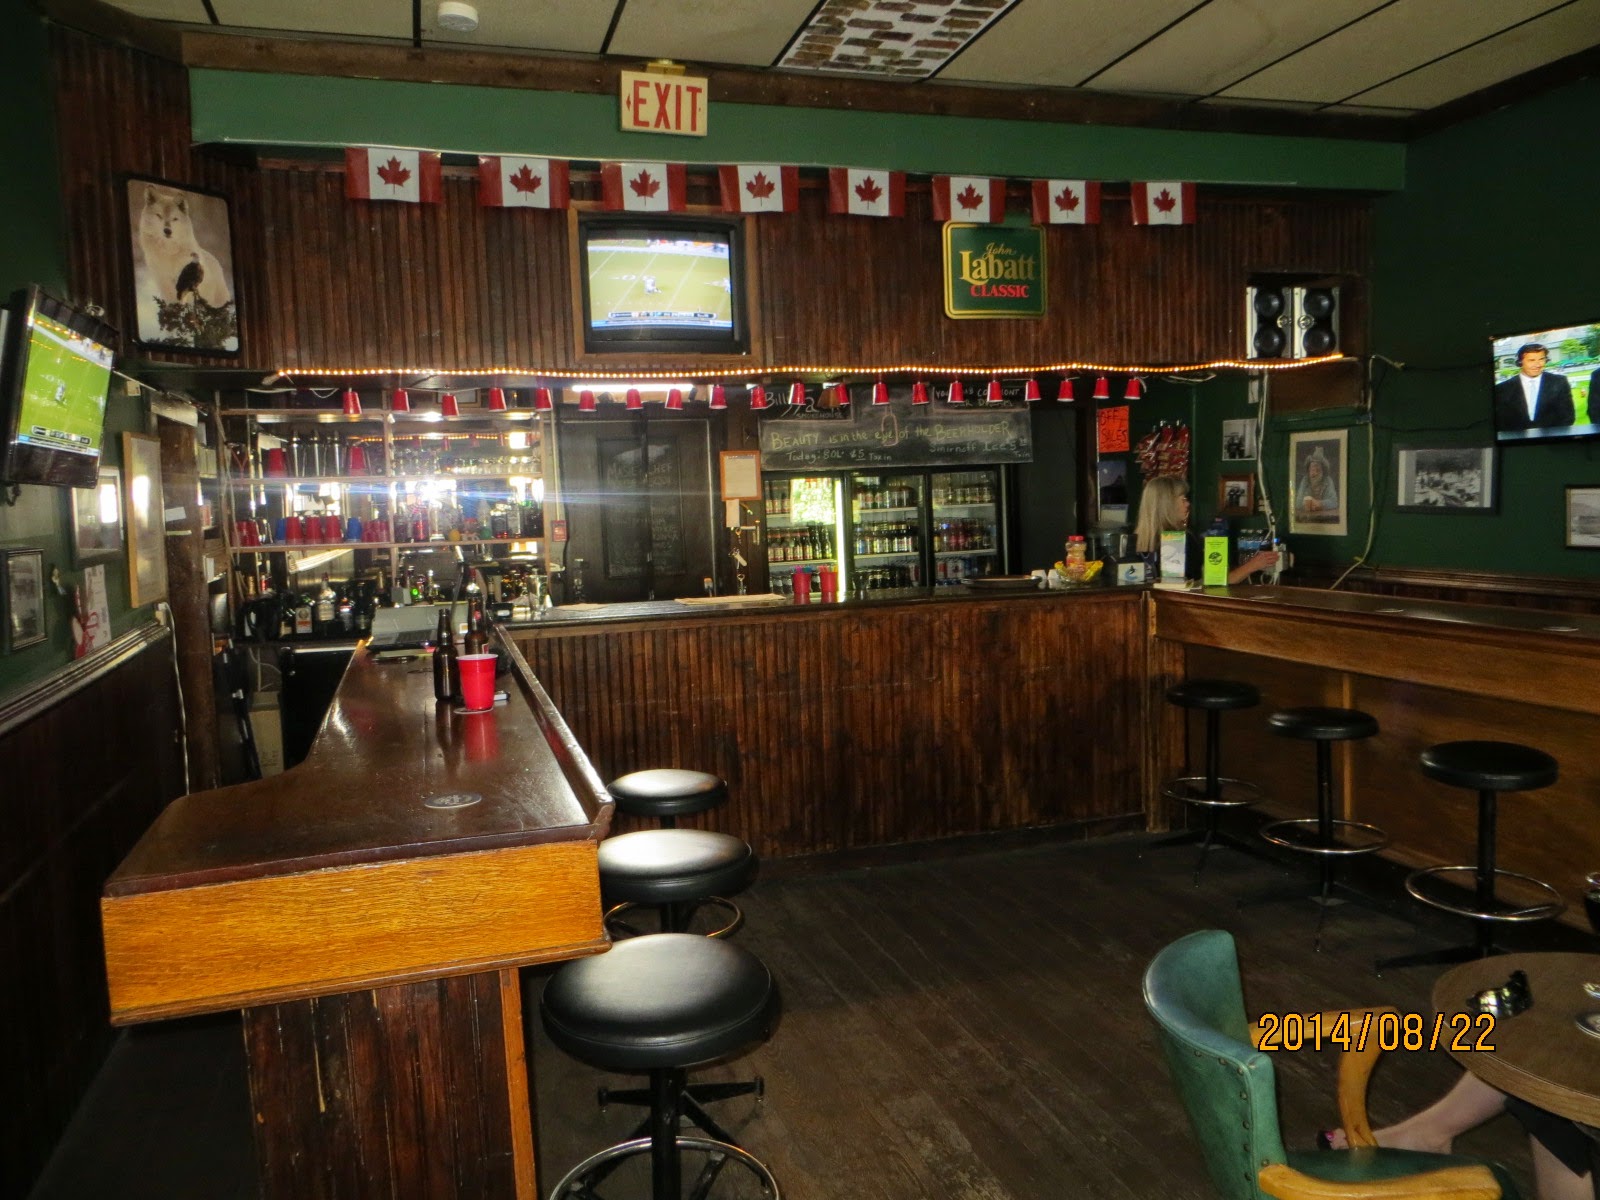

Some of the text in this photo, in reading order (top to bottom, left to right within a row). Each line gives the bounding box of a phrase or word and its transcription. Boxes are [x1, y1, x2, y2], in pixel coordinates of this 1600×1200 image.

[633, 79, 703, 132] EXIT
[982, 242, 1017, 260] John
[958, 250, 1036, 286] Labatt
[969, 284, 1030, 298] CLASSIC
[770, 431, 820, 451] BEAUTY
[852, 430, 869, 442] the
[898, 427, 910, 439] of
[914, 425, 932, 437] the
